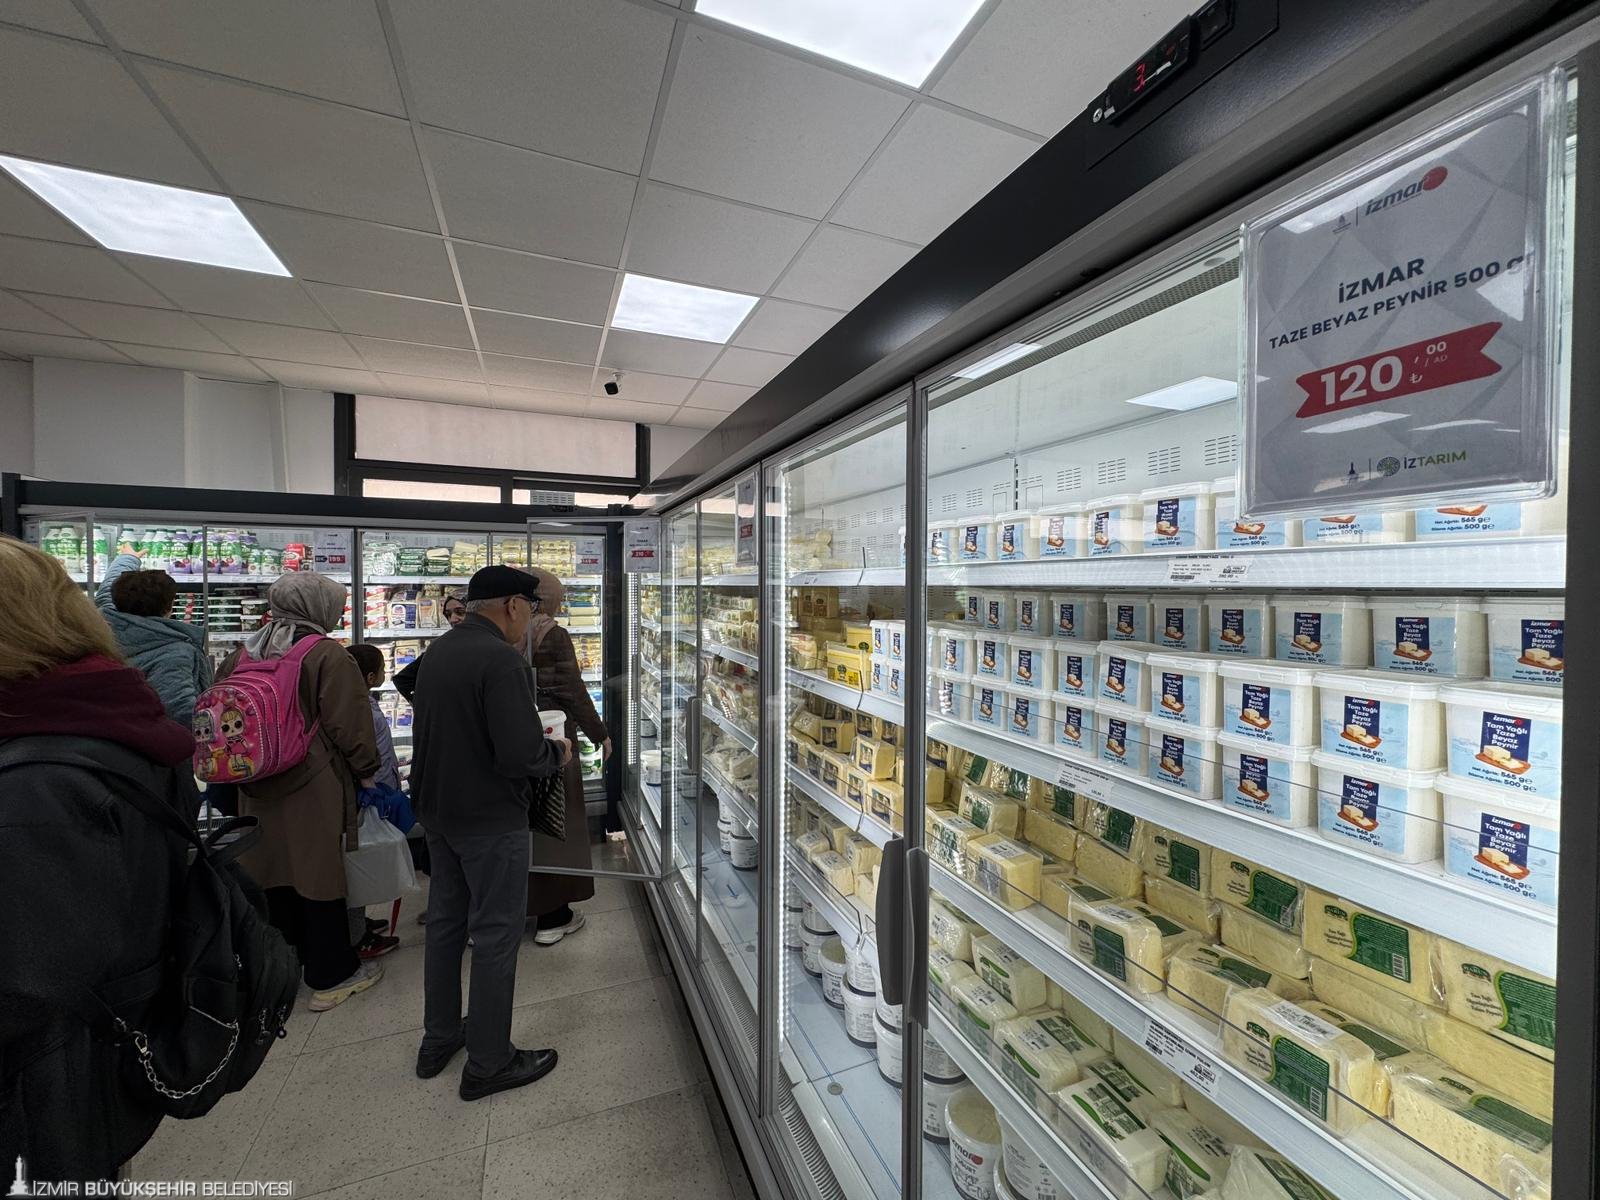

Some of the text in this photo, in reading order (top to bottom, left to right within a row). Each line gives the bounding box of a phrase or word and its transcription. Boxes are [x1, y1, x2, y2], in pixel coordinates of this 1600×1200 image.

[1365, 176, 1426, 216] izmar
[1338, 258, 1425, 303] İZMAR
[1269, 328, 1308, 349] TAZE
[1311, 307, 1369, 336] BEYAZ
[1373, 279, 1448, 315] PEYNİR
[1454, 261, 1500, 288] 500
[1426, 341, 1447, 355] 00
[1320, 355, 1403, 406] 120
[1404, 450, 1466, 470] İZTARIM
[1486, 721, 1528, 735] Tam Yağlı
[1496, 729, 1515, 738] Taze
[1492, 739, 1519, 750] Peynir
[1493, 734, 1518, 744] Beyaz
[1501, 771, 1517, 780] 565
[1504, 779, 1521, 788] 500
[1485, 823, 1527, 840] Tam Yağlı
[1489, 842, 1517, 854] Peynir
[1503, 883, 1521, 893] 500
